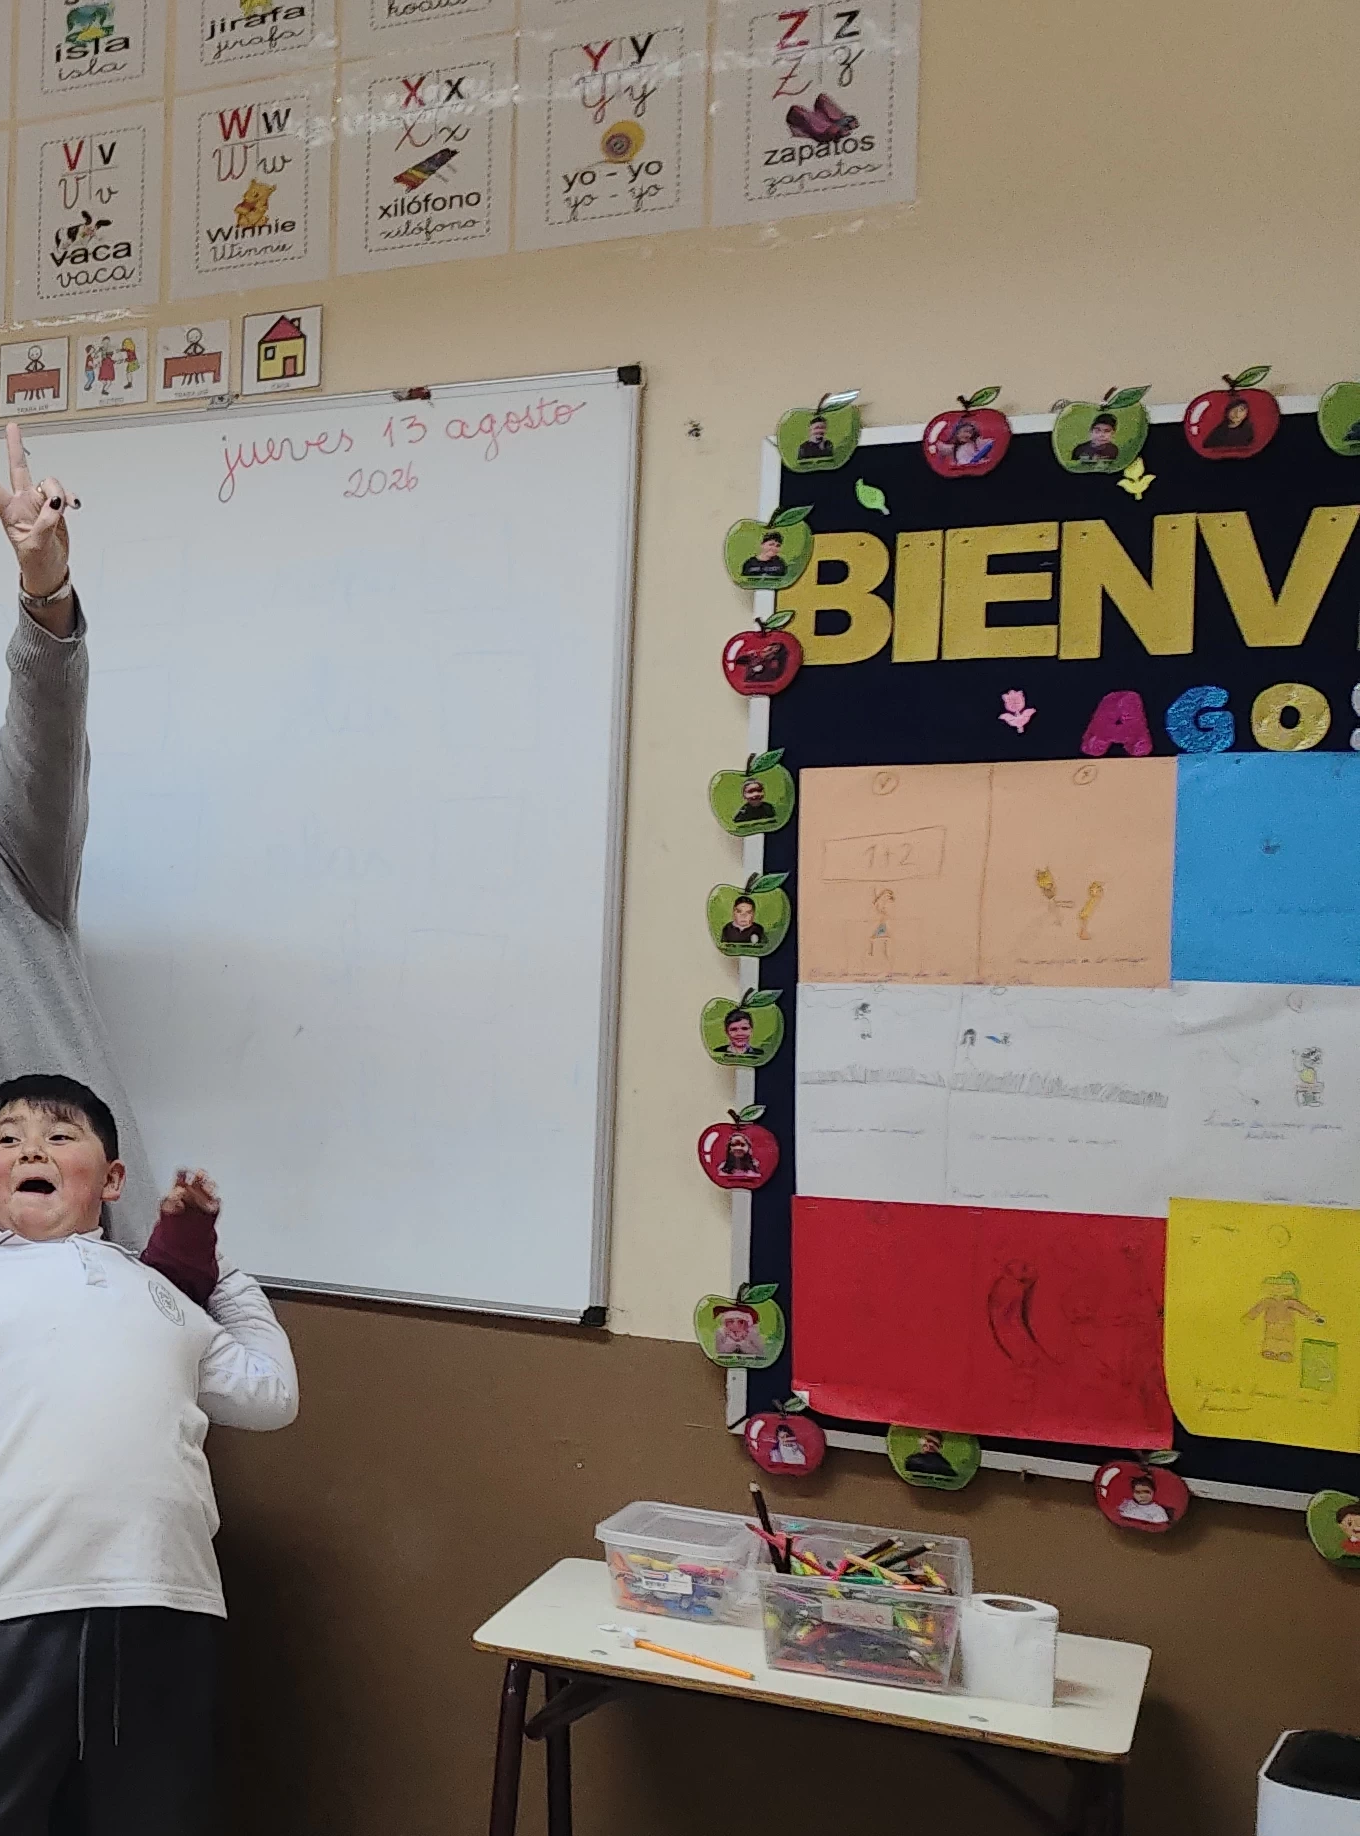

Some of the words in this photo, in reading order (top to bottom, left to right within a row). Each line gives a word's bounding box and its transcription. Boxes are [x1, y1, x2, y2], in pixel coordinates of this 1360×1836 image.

[206, 4, 305, 40] jirafa
[776, 9, 810, 50] Z
[55, 35, 131, 63] isla
[582, 39, 613, 72] Y
[401, 76, 427, 109] X
[218, 105, 253, 141] W
[63, 139, 85, 172] V
[764, 134, 876, 167] zapatos
[377, 190, 482, 221] xilófono
[206, 218, 297, 244] Winnie
[49, 241, 133, 268] vaca
[56, 264, 136, 289] vaca
[217, 428, 355, 504] jueves
[381, 413, 429, 449] 13
[444, 396, 588, 463] agosto
[342, 460, 420, 500] 2026
[777, 505, 1360, 667] BIENV
[1081, 683, 1360, 758] AGO
